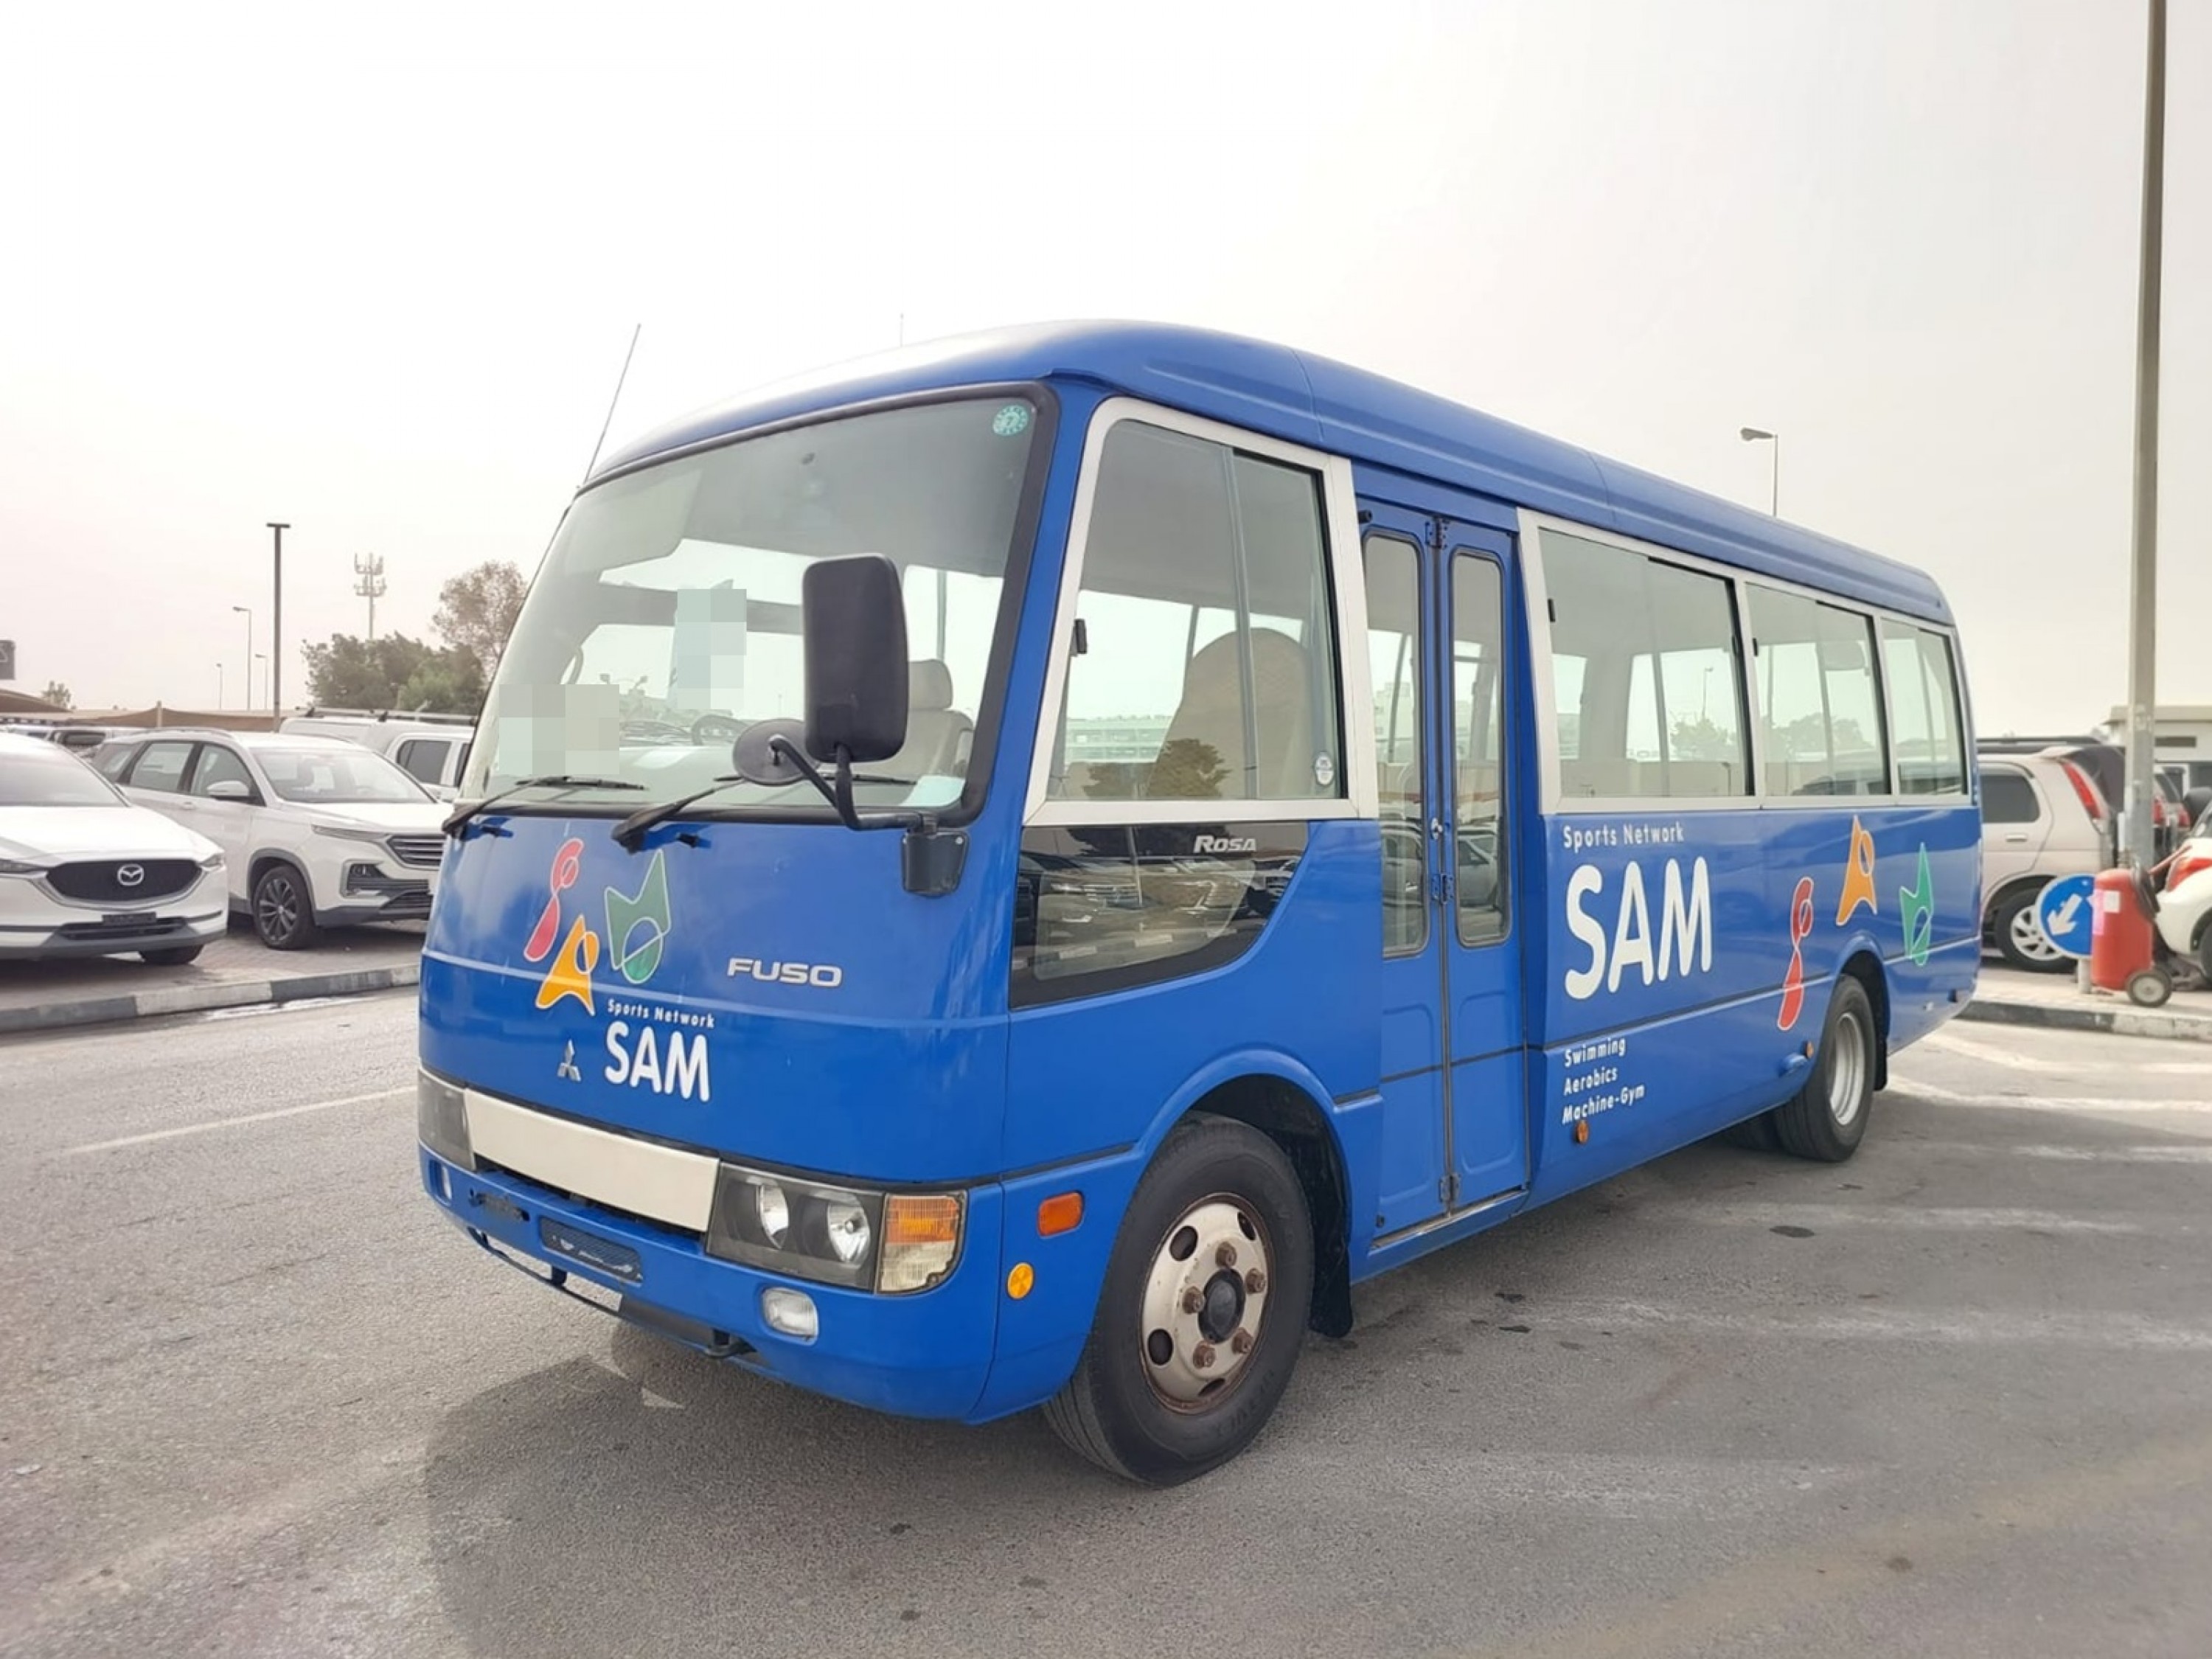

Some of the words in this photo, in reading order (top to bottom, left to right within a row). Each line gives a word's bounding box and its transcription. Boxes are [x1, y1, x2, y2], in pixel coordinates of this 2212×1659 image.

[1194, 834, 1257, 854] ROSA
[1563, 824, 1617, 854] Sports
[1624, 821, 1686, 845] Network
[1564, 855, 1712, 1000] SAM
[726, 957, 843, 988] FUSO
[607, 998, 650, 1018] Sports
[654, 1006, 715, 1029] Network
[605, 1020, 711, 1102] SAM
[1564, 1037, 1626, 1068] Swimming
[1563, 1066, 1618, 1097] Aerobics
[1562, 1085, 1645, 1125] Machine-Gym
